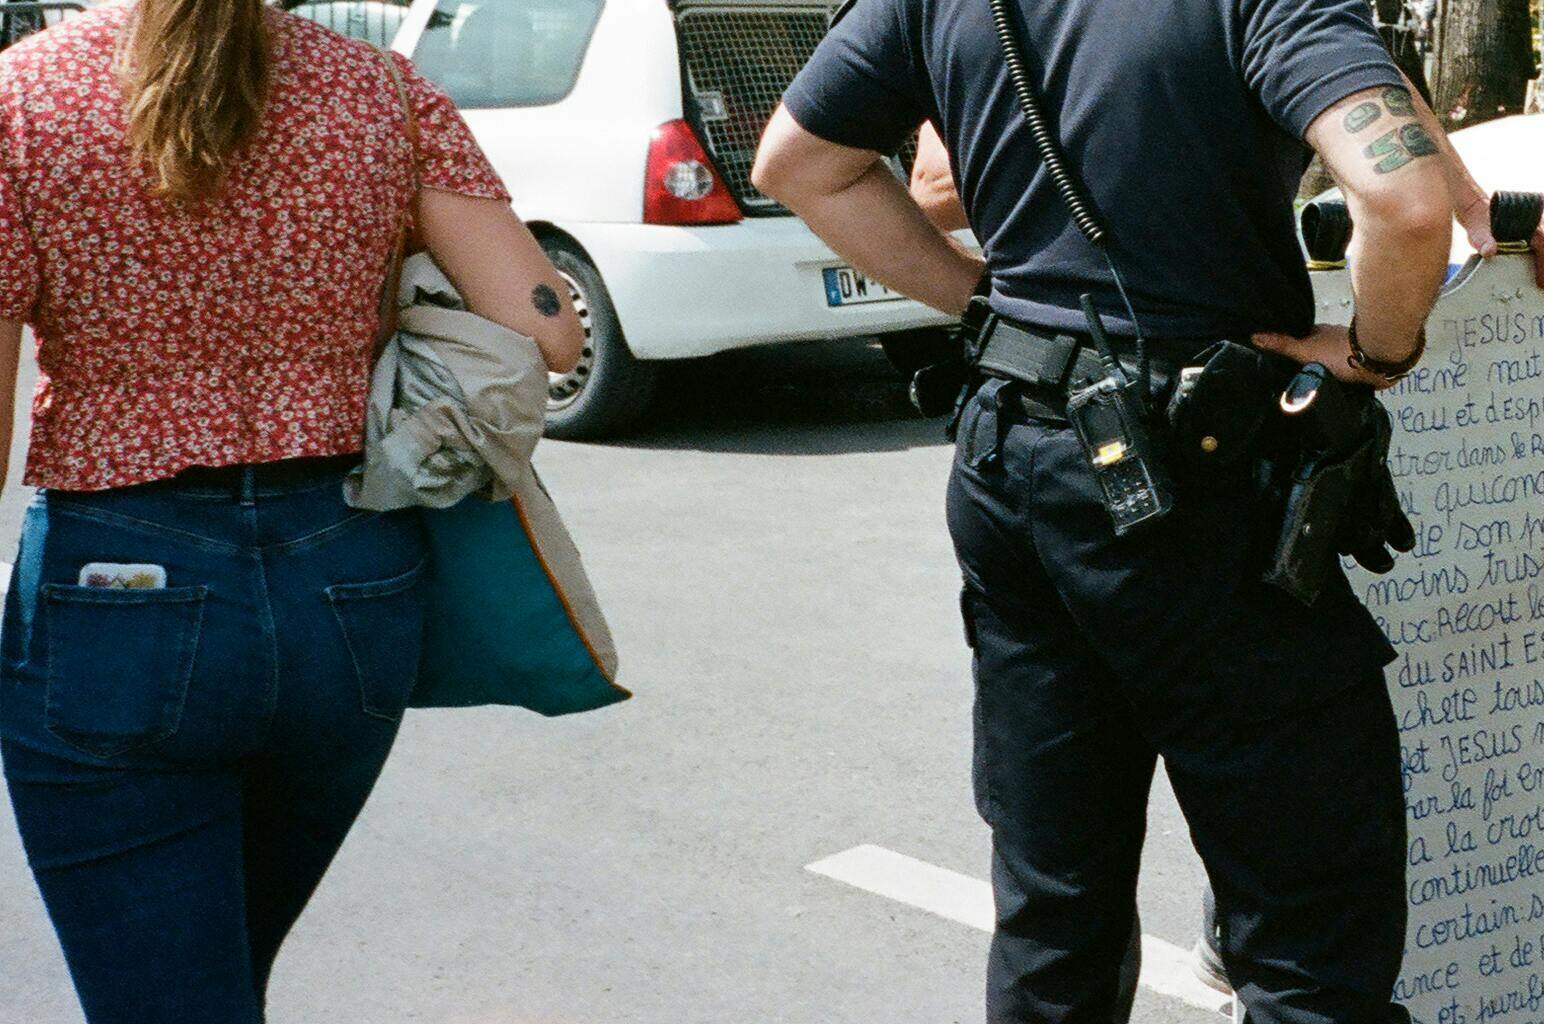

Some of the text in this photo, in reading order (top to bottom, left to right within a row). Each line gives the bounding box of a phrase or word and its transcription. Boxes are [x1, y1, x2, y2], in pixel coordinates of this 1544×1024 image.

[1444, 312, 1527, 365] JESUS
[1455, 392, 1480, 427] et
[1456, 438, 1507, 468] dans
[1454, 519, 1513, 550] son
[1365, 563, 1469, 607] moins
[1398, 651, 1436, 688] du
[1440, 724, 1522, 782] JESUS
[1448, 781, 1475, 813] la
[1483, 767, 1513, 821] foi
[1443, 821, 1478, 857] la
[1478, 944, 1504, 976] et
[1509, 934, 1534, 969] de
